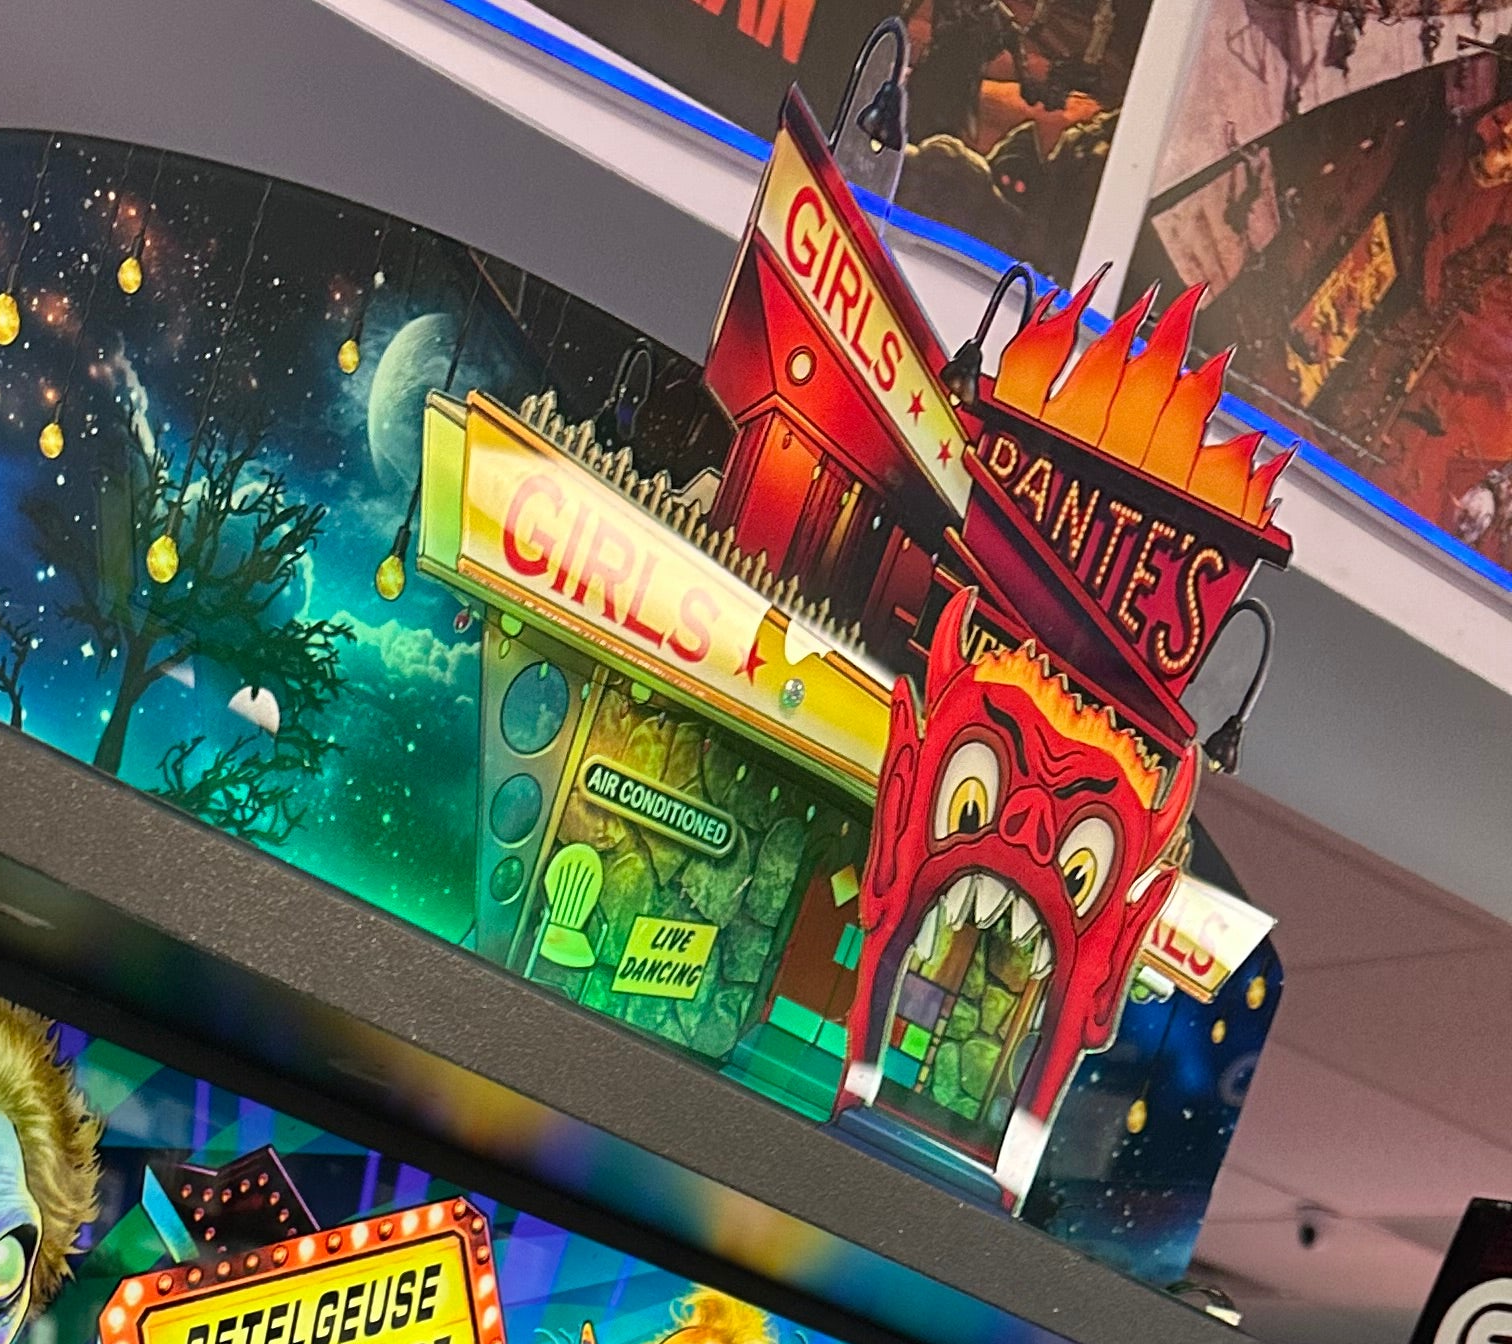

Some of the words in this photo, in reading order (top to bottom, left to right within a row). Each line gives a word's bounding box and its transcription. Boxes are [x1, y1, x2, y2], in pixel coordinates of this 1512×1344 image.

[785, 186, 903, 391] GIRLS
[503, 475, 722, 663] GIRLS
[989, 436, 1226, 672] DANTE'S
[588, 766, 620, 801] AIR
[619, 779, 728, 845] CONDITIONED
[619, 956, 703, 988] DANCING
[651, 926, 696, 953] LIVE
